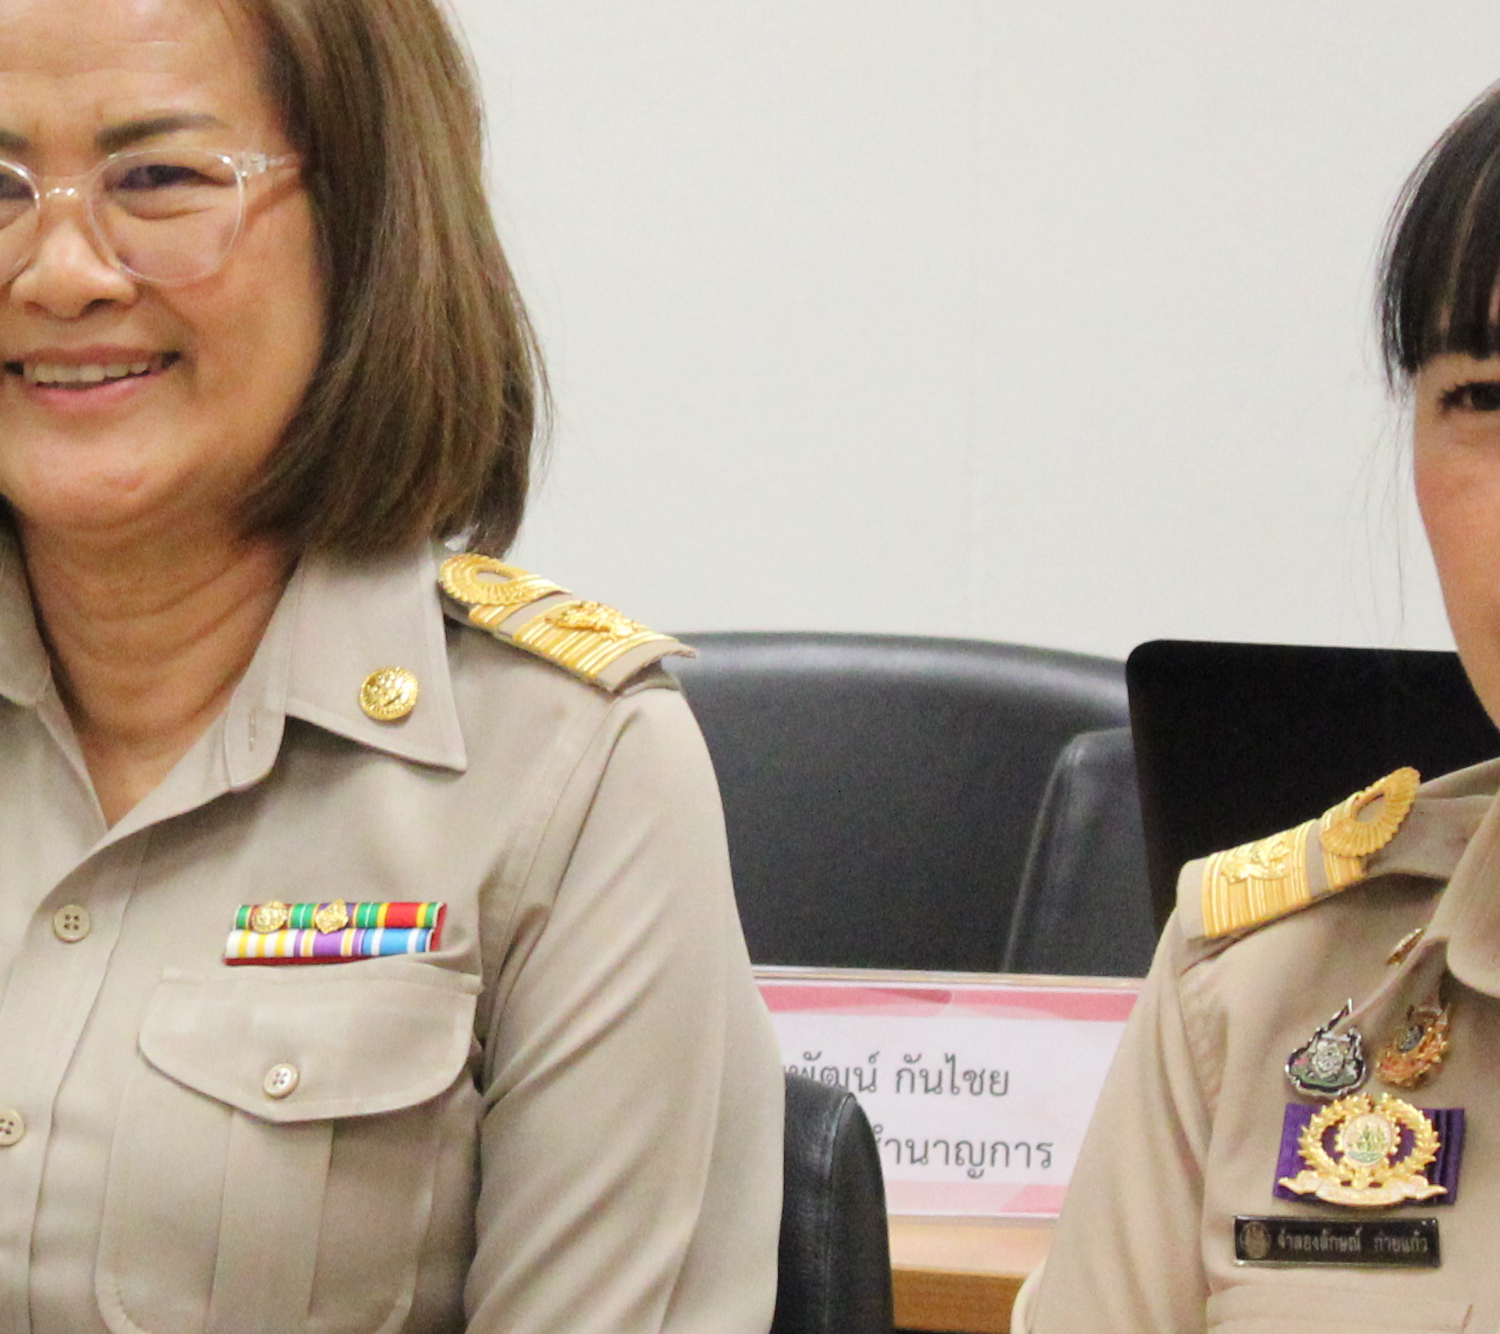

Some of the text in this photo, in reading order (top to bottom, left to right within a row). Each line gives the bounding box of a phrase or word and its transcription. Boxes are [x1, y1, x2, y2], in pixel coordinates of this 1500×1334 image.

[894, 1053, 1011, 1099] กันไชย
[873, 1125, 1054, 1180] ำนาญการ
